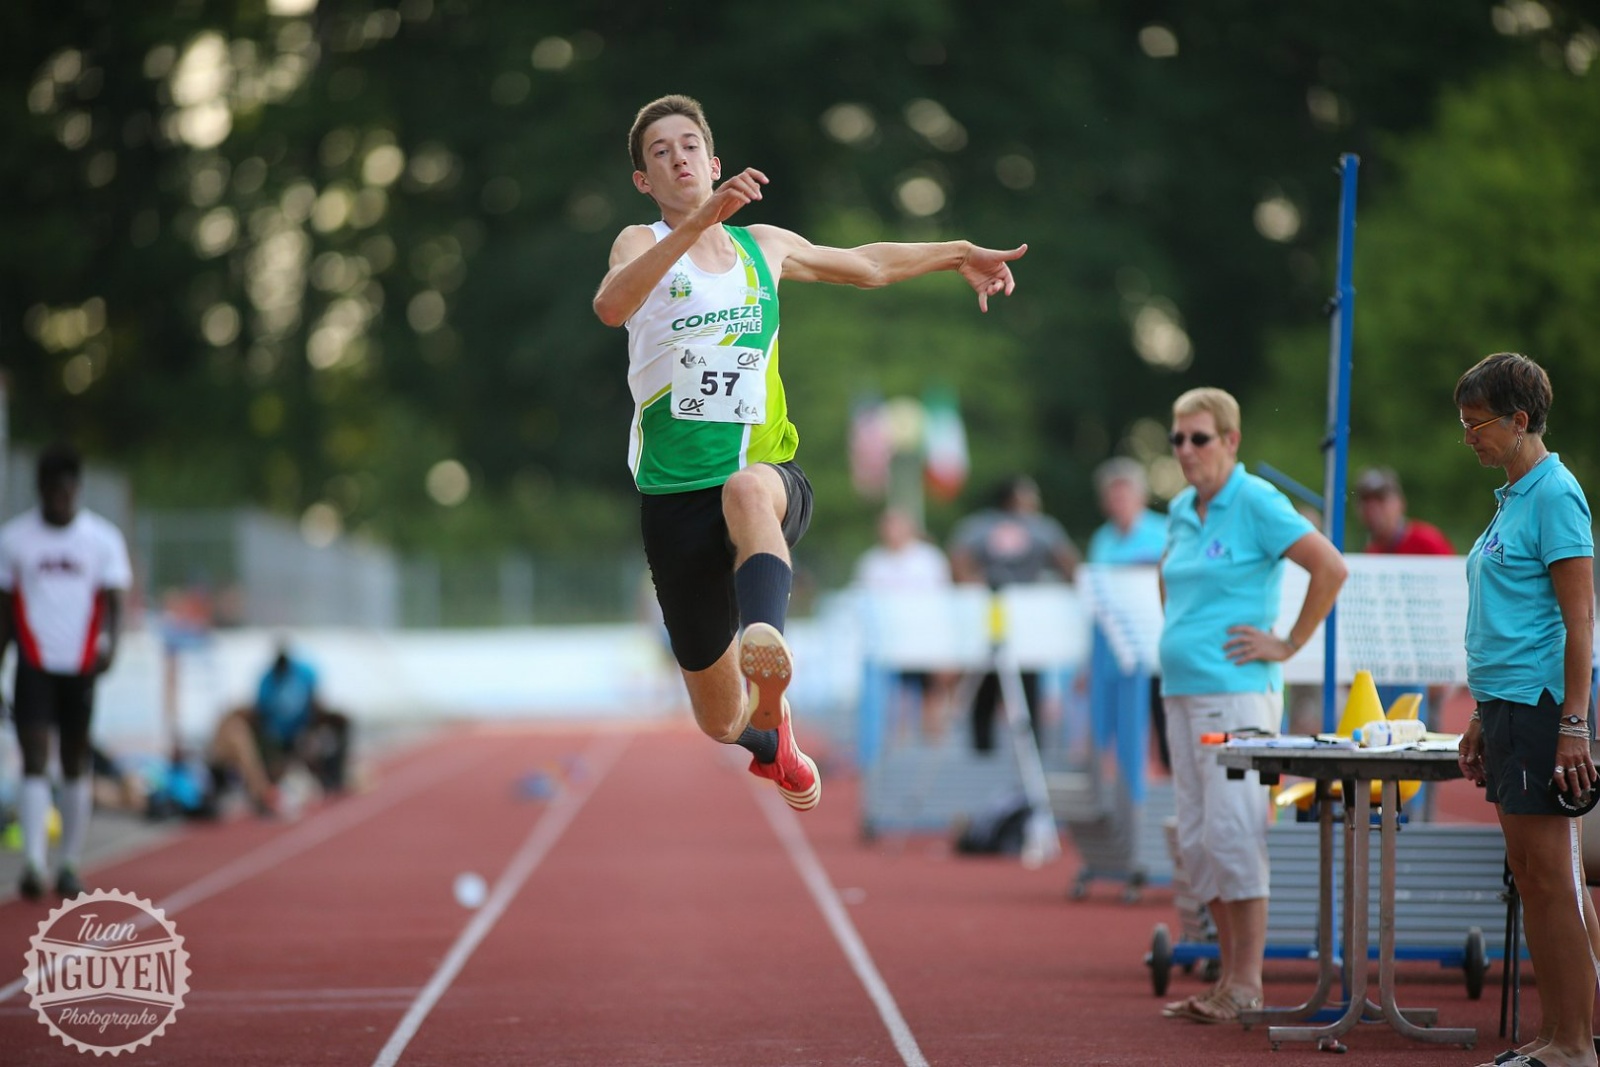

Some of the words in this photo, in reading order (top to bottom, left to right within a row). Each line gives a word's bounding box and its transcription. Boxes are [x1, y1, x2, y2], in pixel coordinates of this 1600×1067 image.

[671, 305, 761, 331] CORREZE
[725, 320, 761, 334] ATHLE
[700, 371, 741, 396] 57
